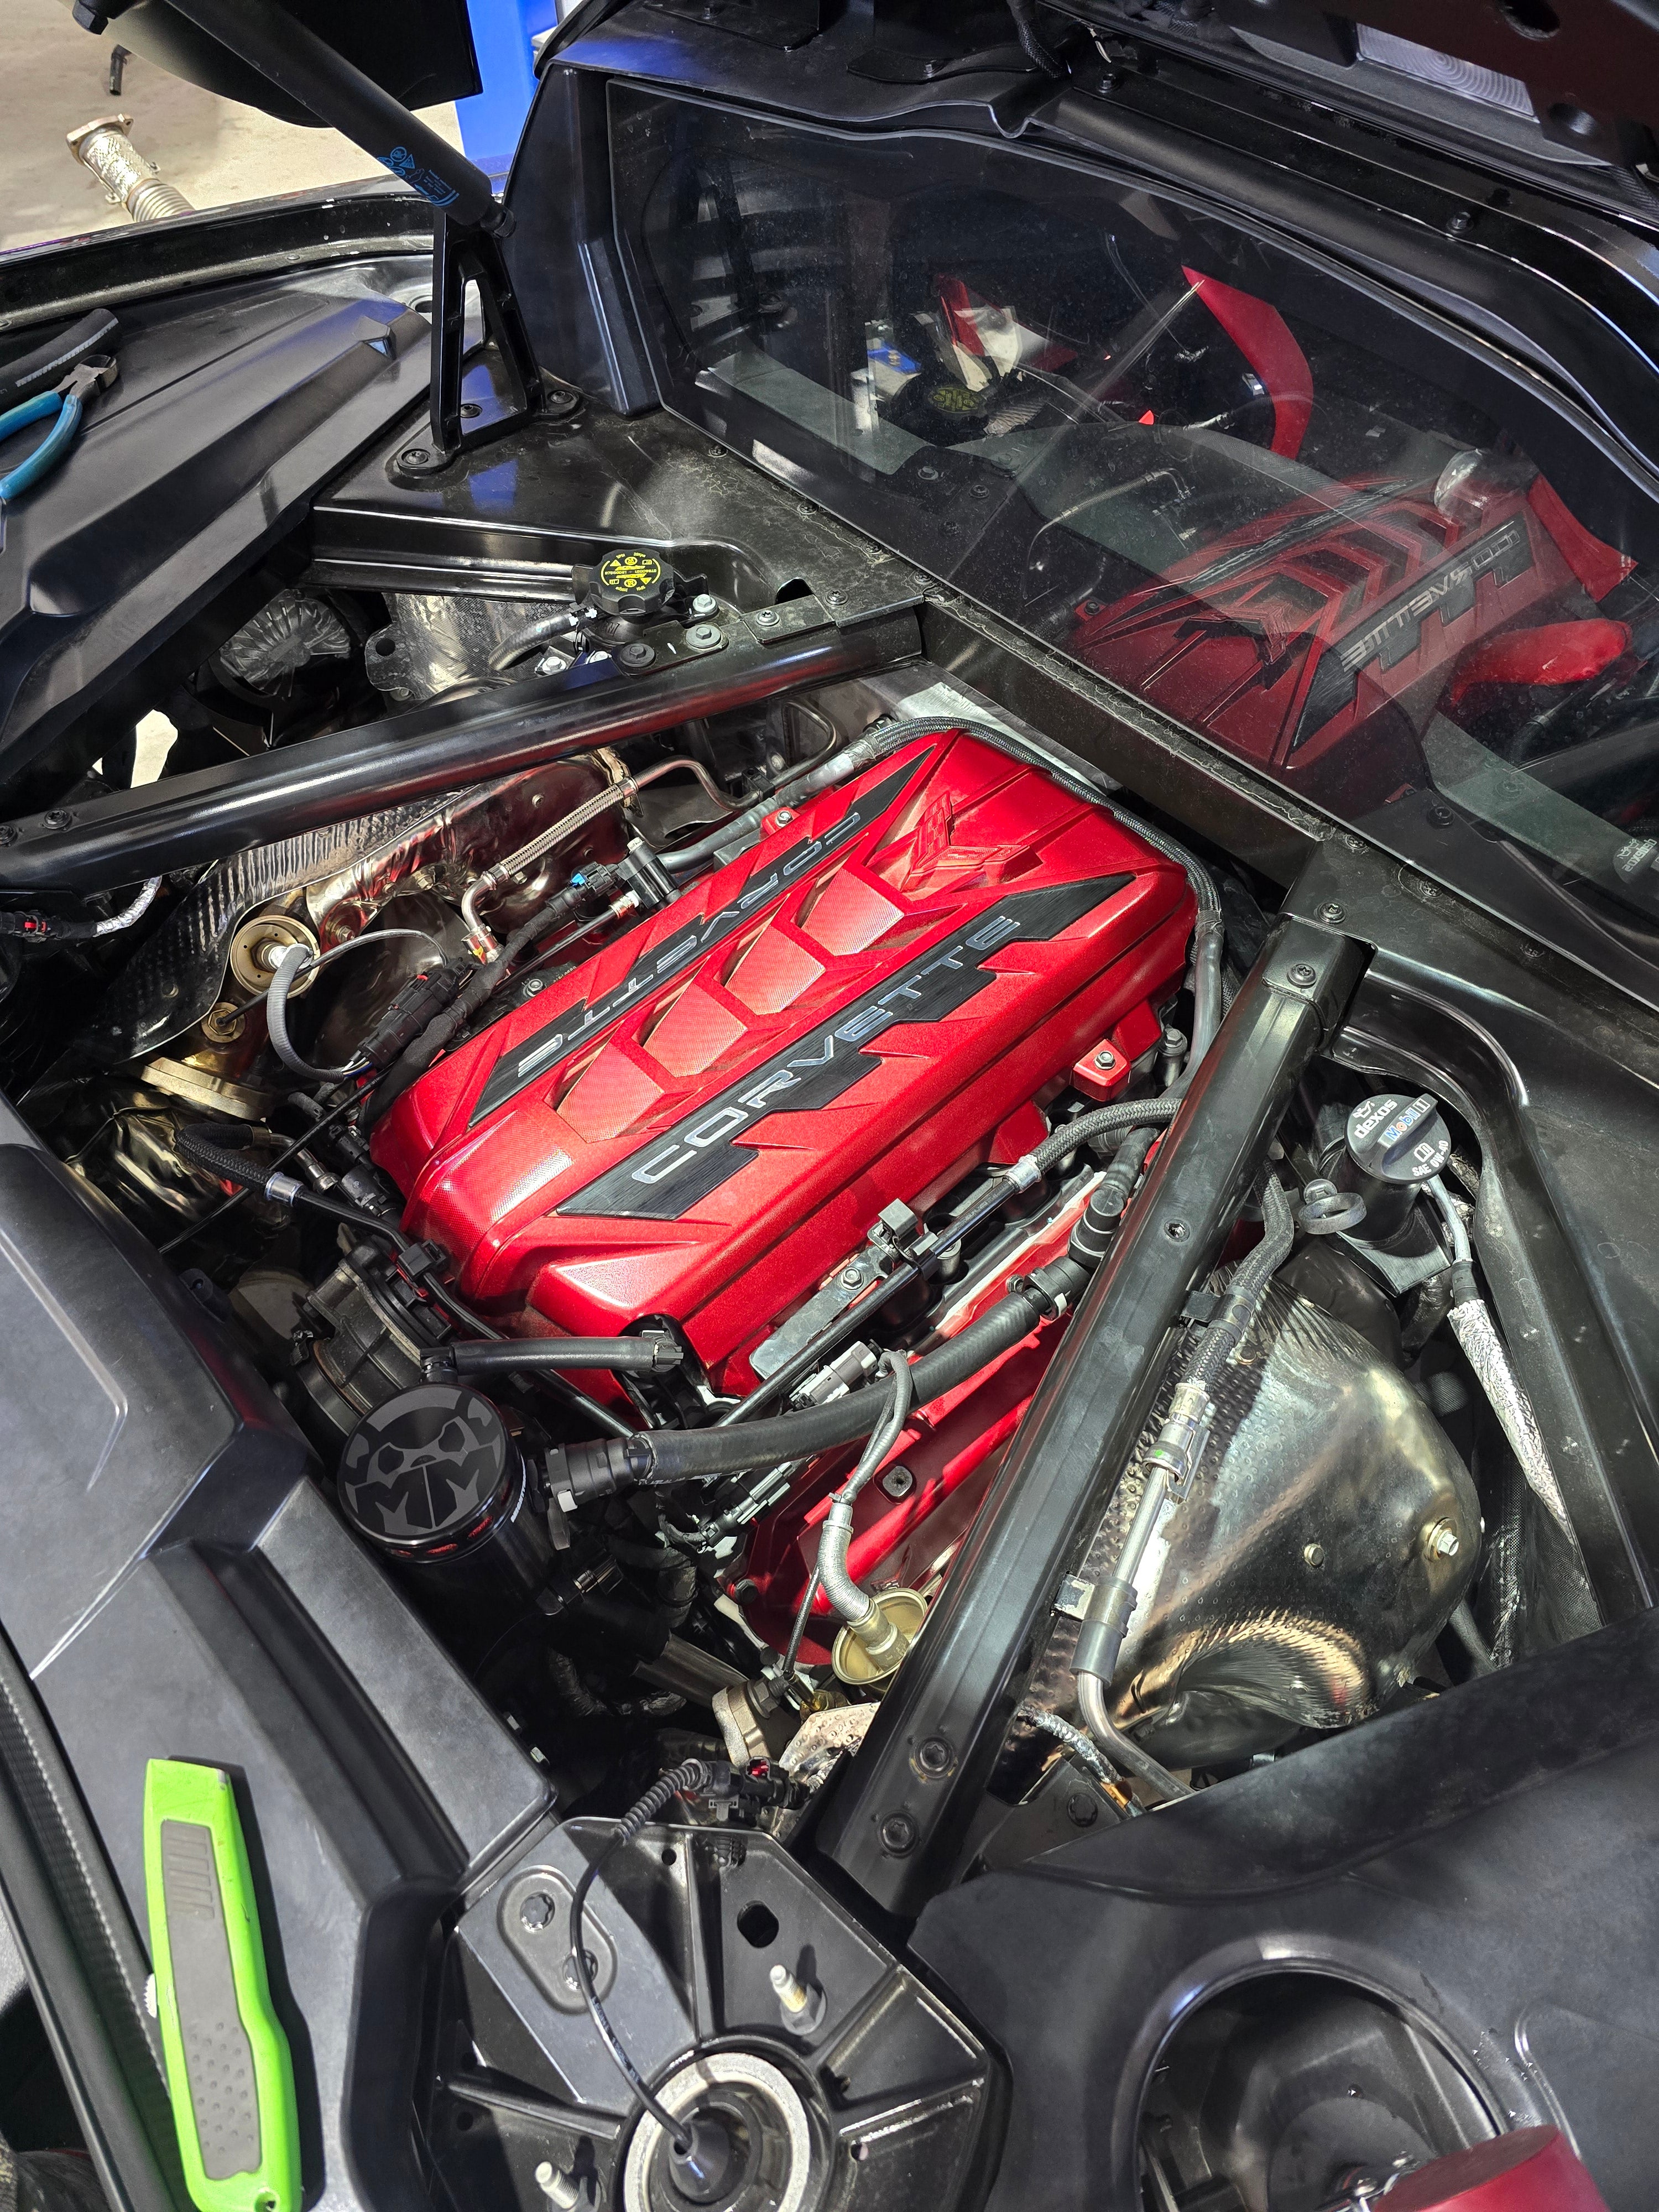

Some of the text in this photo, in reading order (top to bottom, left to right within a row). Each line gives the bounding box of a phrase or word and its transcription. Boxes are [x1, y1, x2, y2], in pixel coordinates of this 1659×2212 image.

[517, 812, 860, 1078] CORVETTE
[631, 915, 1021, 1185] CORVETTE
[1354, 1099, 1398, 1139] dexos
[1383, 1098, 1431, 1142] Mobil 1
[1412, 1140, 1449, 1177] SAE 0W-40
